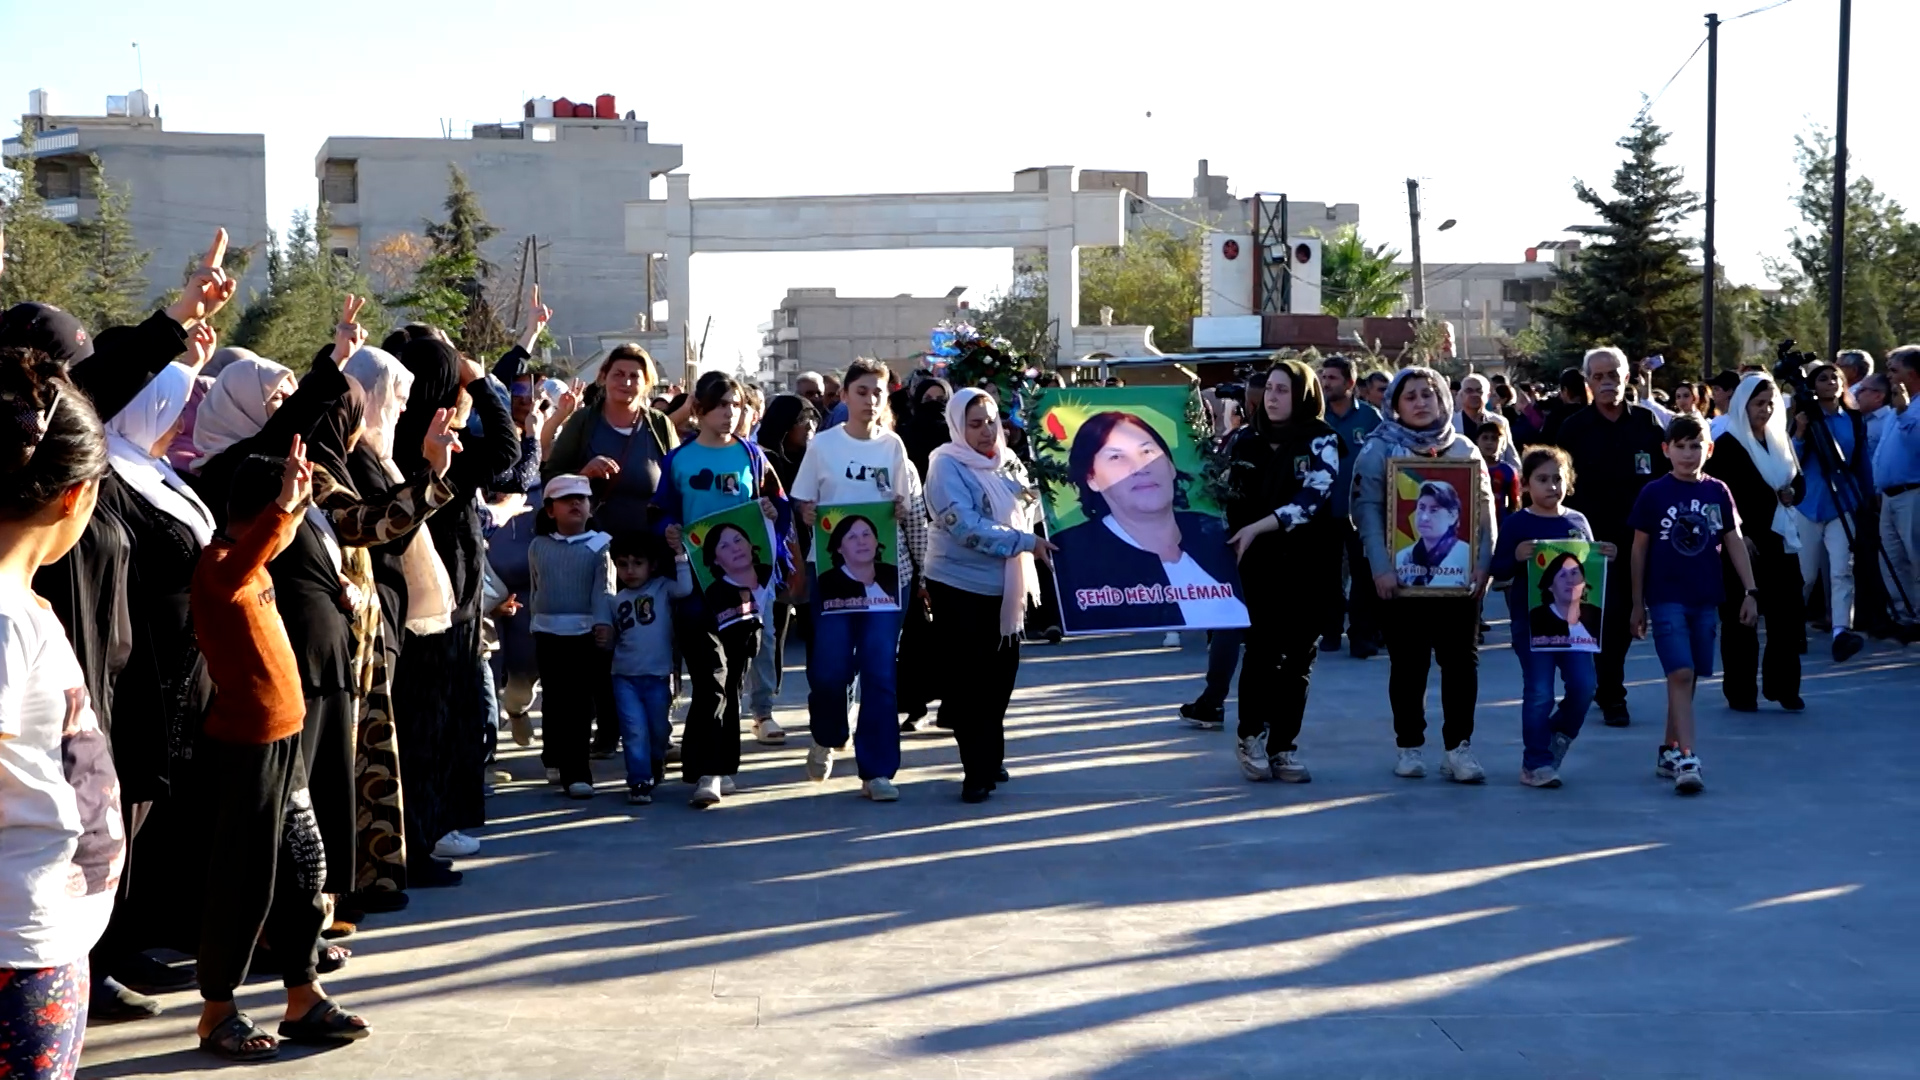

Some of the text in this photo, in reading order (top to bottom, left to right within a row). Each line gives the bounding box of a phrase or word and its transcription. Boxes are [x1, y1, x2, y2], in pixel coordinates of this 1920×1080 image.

[1076, 582, 1233, 611] ŞEHÎD HÊVÎ SILÊMAN
